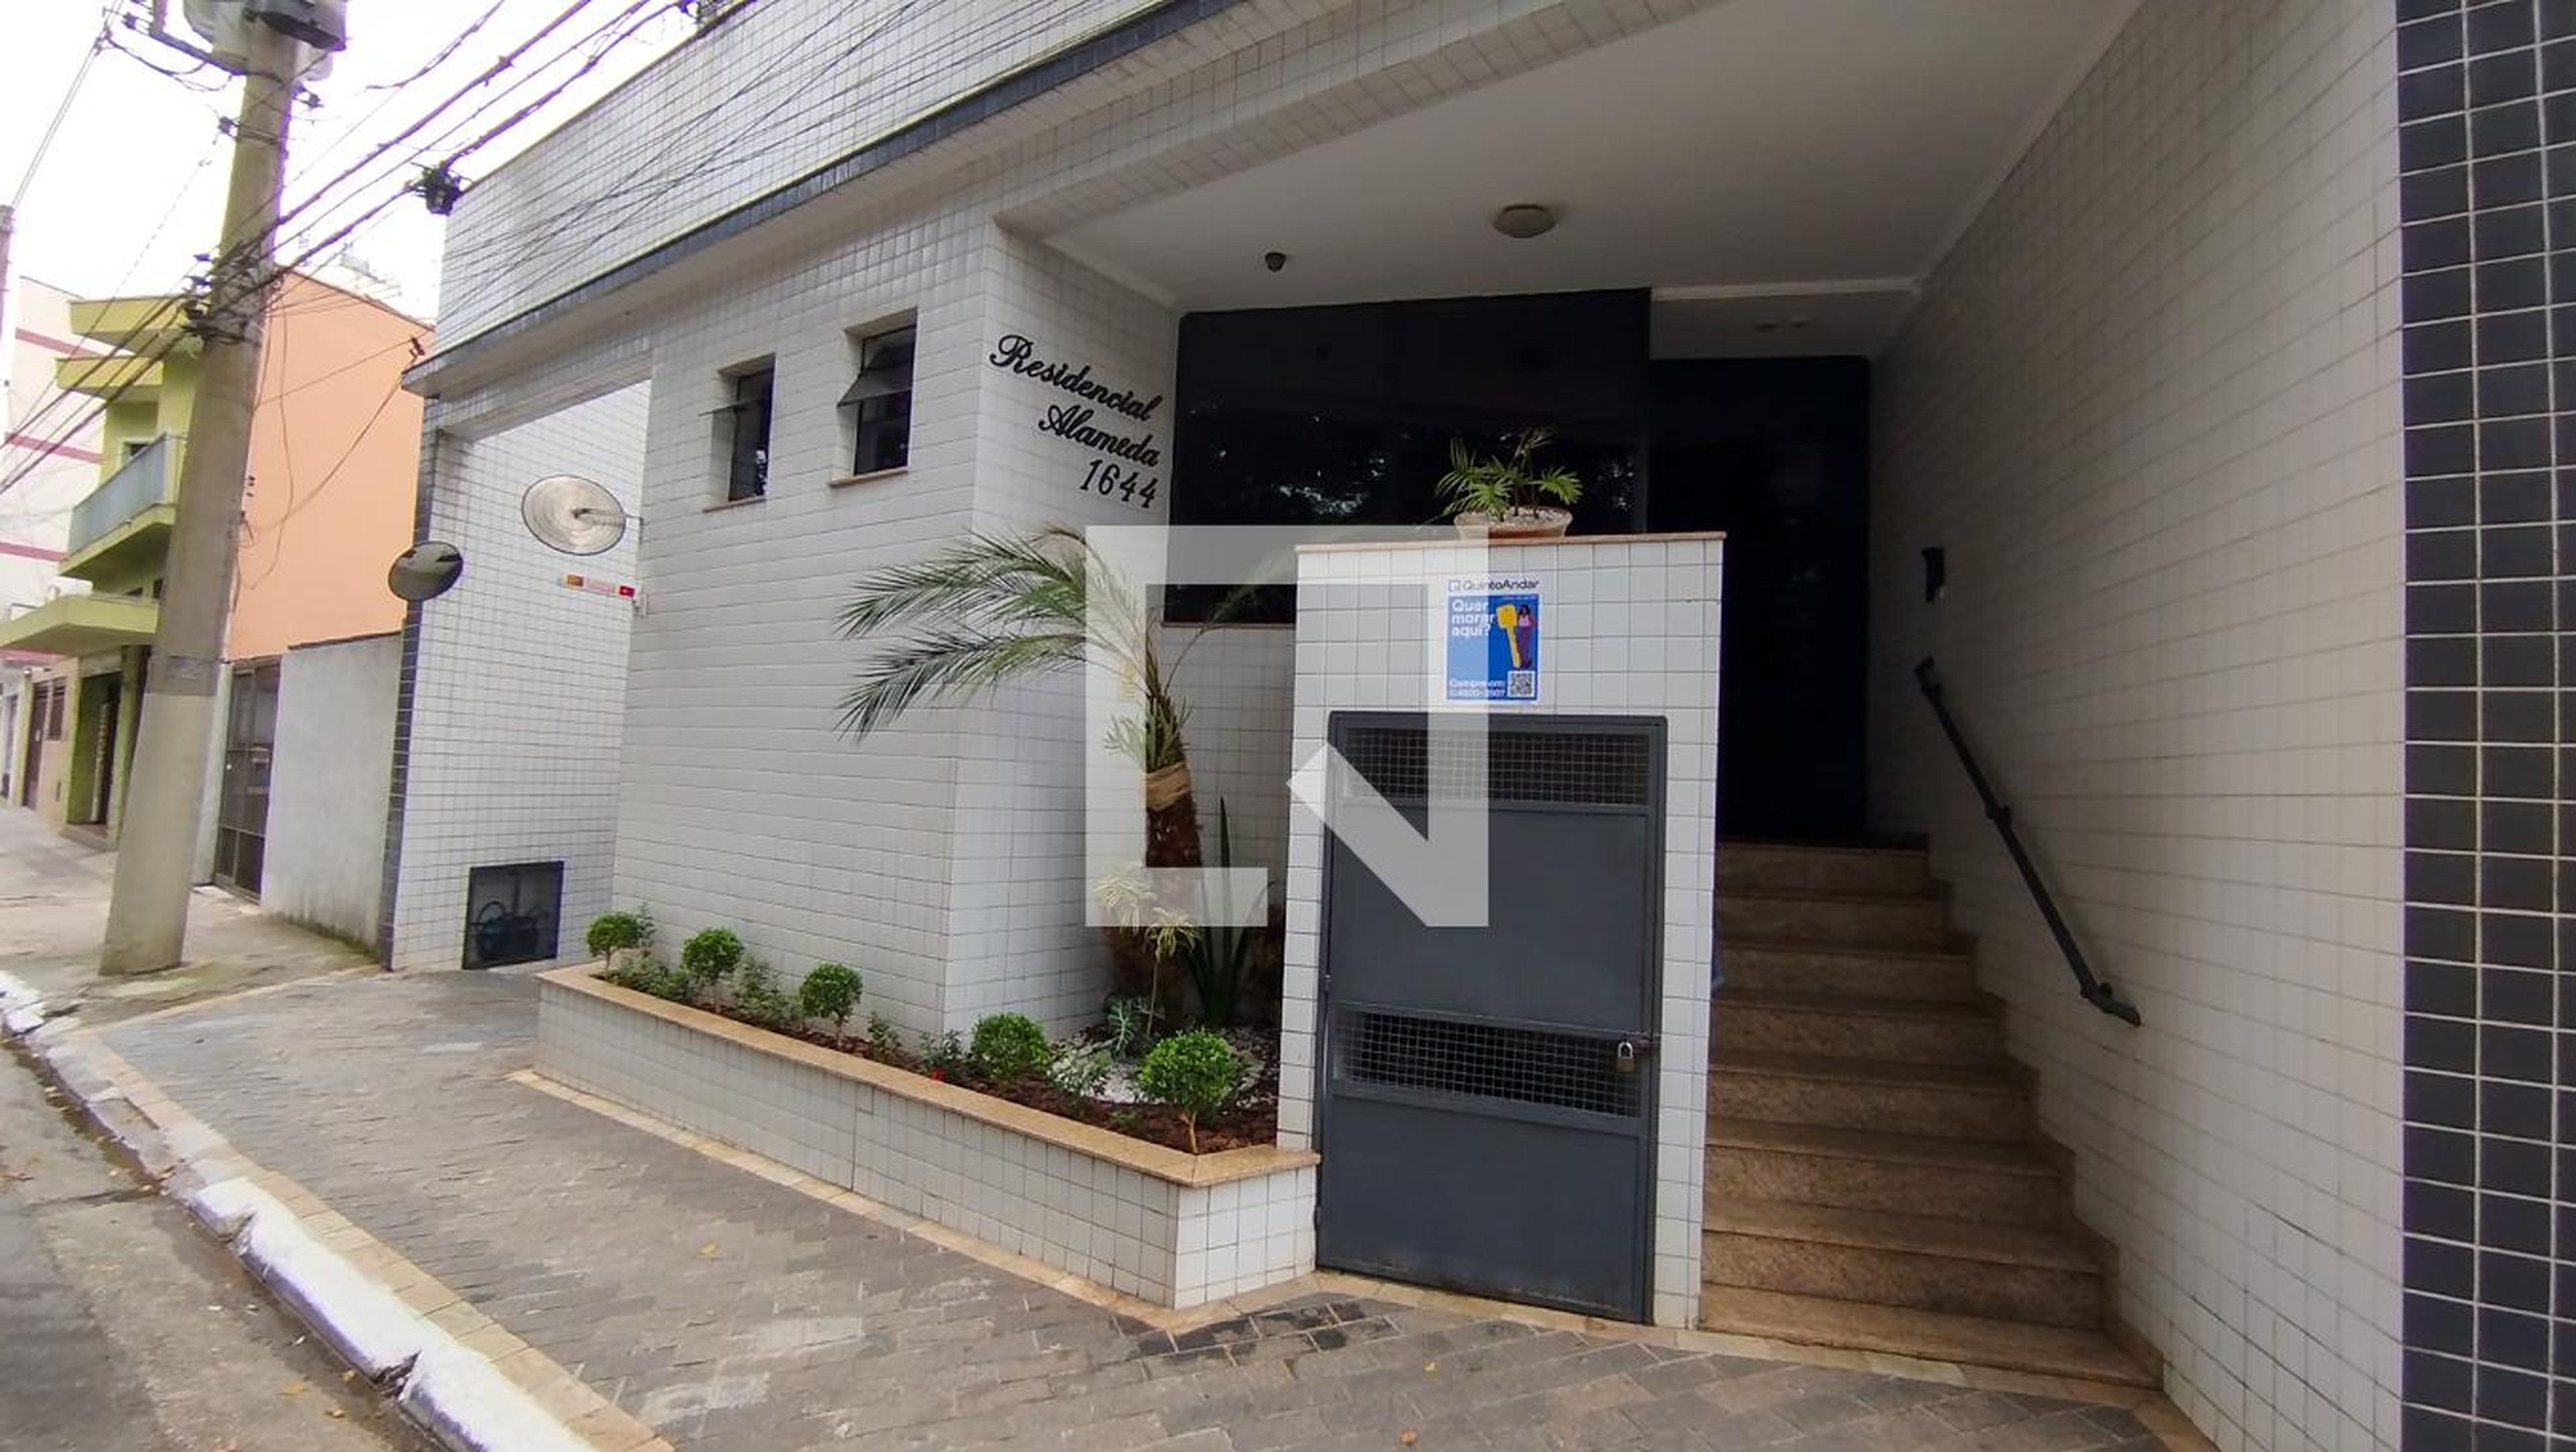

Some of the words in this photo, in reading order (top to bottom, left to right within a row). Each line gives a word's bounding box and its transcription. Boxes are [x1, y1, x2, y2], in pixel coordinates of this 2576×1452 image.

[989, 335, 1163, 421] Residencial
[1038, 405, 1161, 467] Alameda
[1080, 459, 1159, 508] 1644
[1462, 579, 1539, 590] QuintoAndar
[1452, 624, 1491, 638] aqui?
